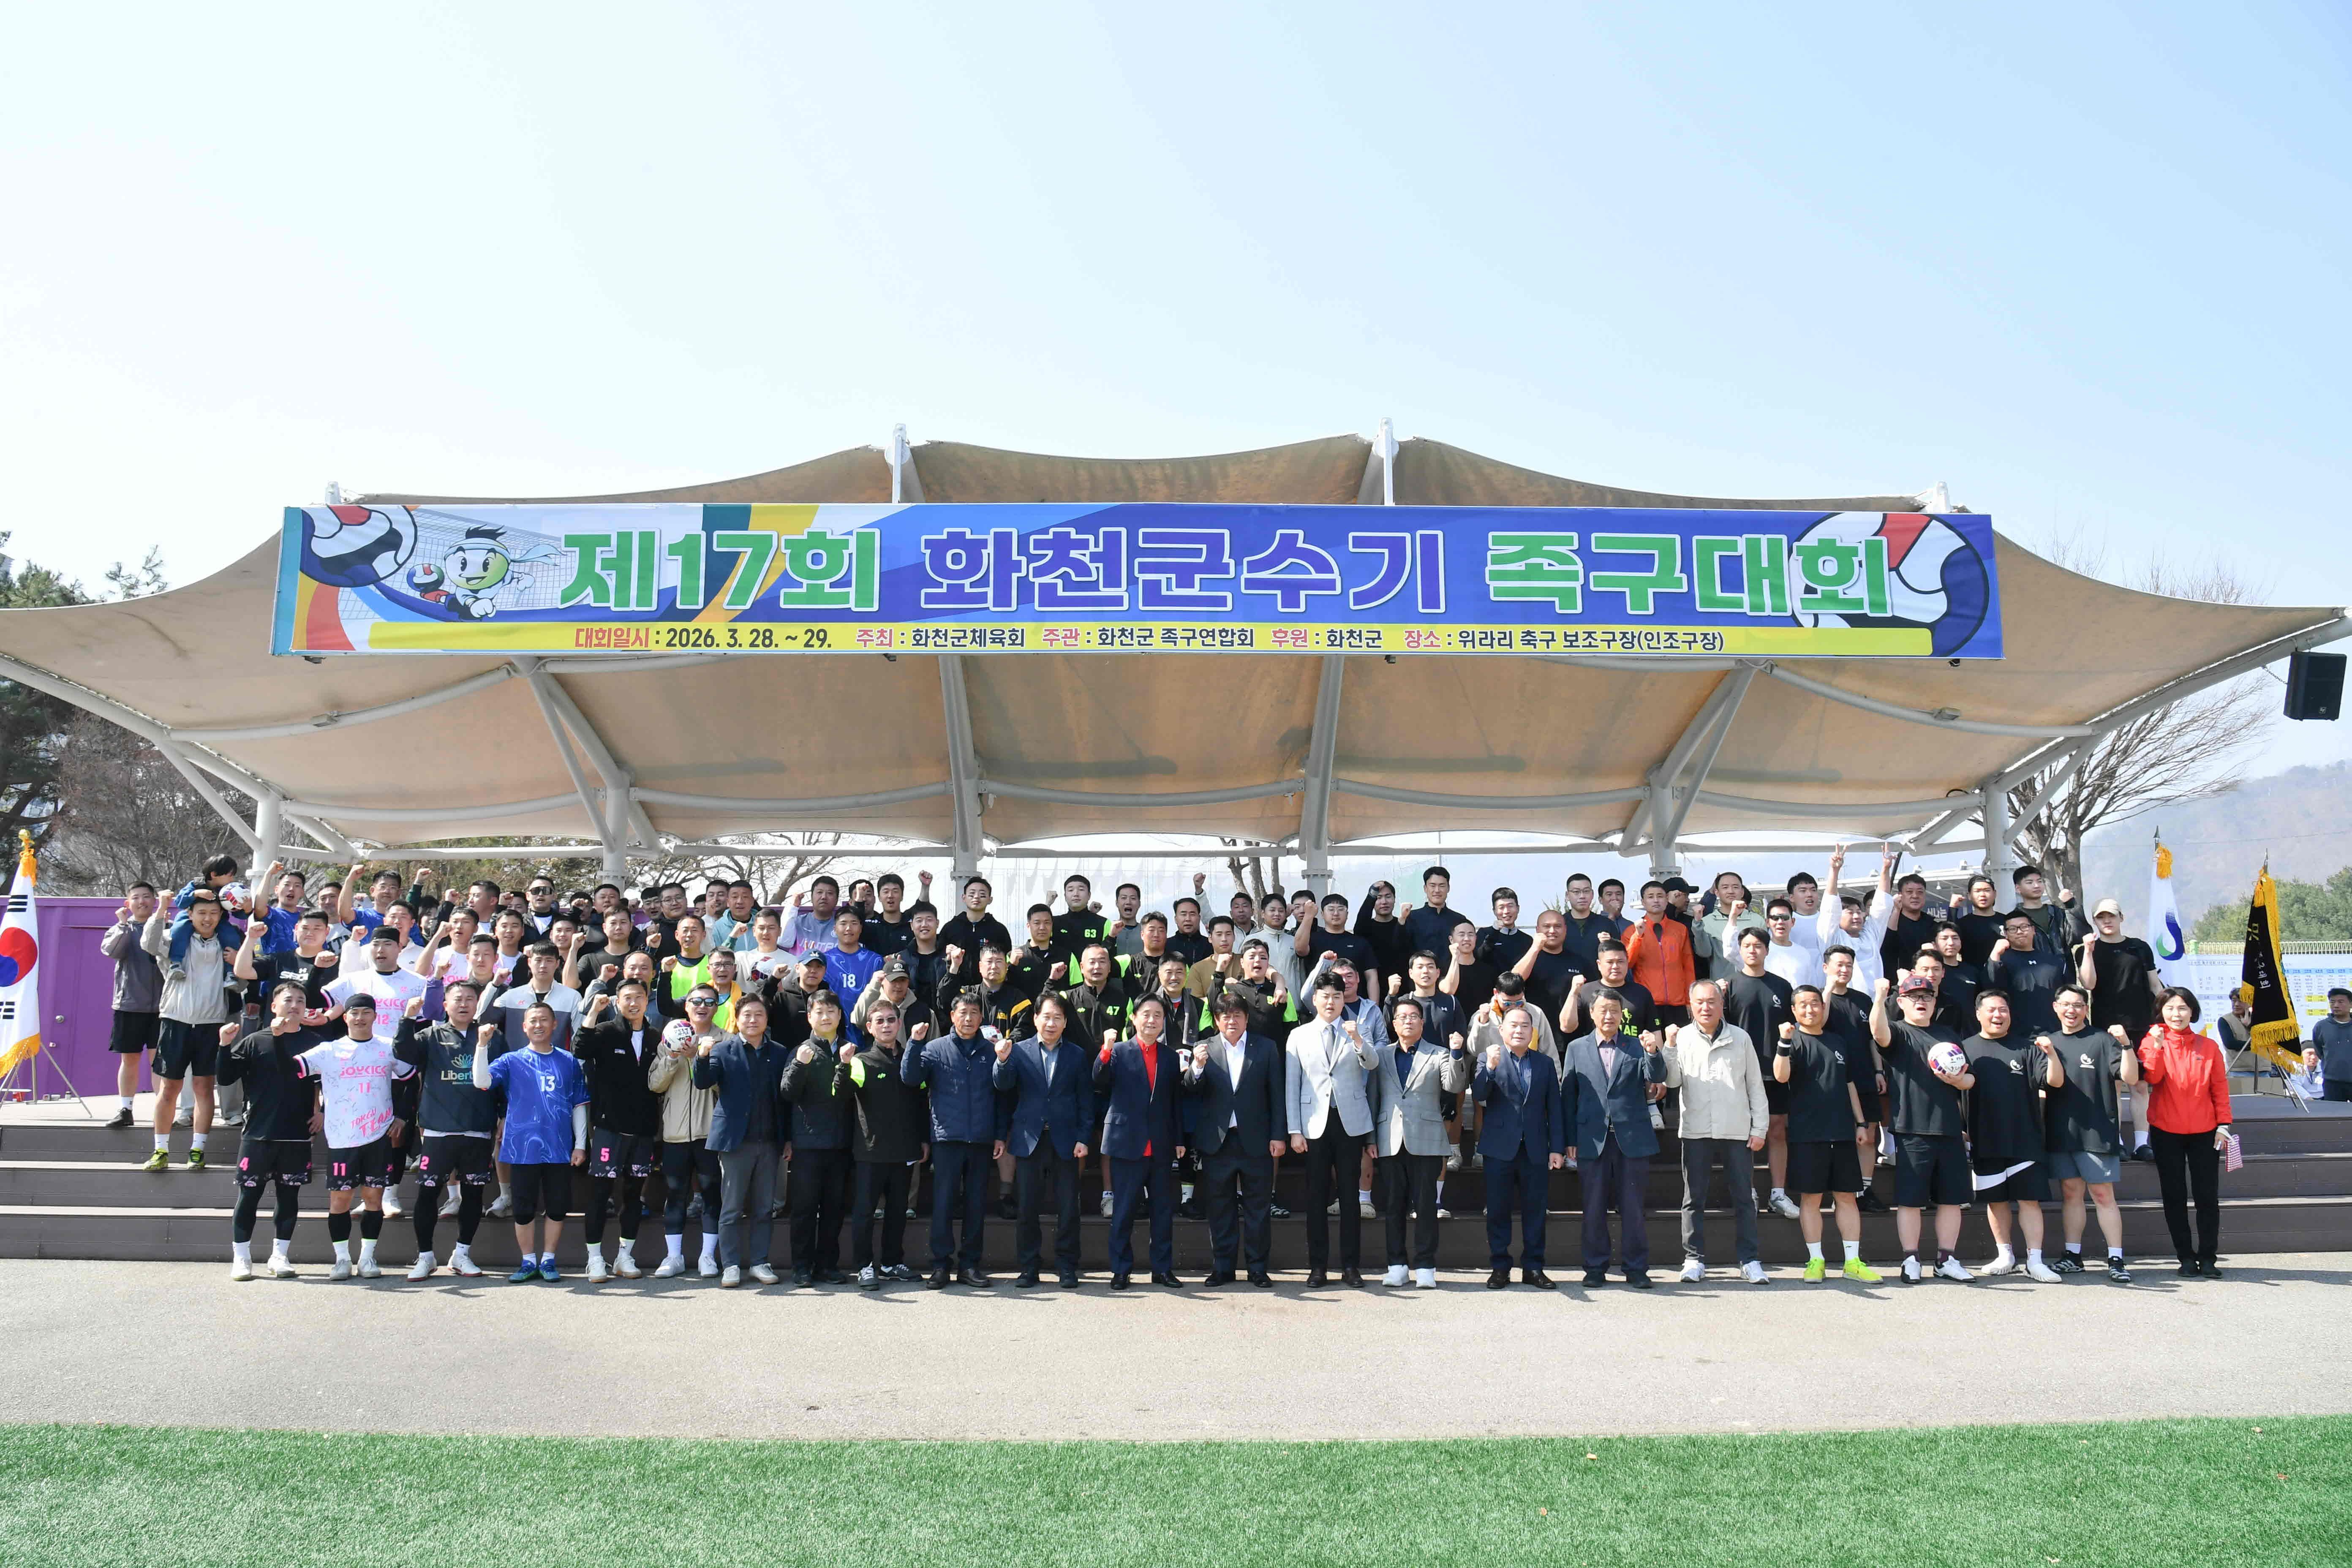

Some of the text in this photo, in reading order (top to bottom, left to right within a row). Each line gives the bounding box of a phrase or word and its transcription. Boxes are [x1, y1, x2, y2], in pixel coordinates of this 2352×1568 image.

[558, 527, 1892, 618] 제17회 화천군수기 족구대회
[574, 628, 650, 648] 대회일시
[666, 628, 720, 648] 2026.
[727, 629, 742, 648] 3.
[749, 629, 779, 648] 28.
[803, 629, 832, 648] 29.
[911, 628, 1025, 648] 화천군체육회
[1097, 627, 1154, 647] 화천군
[1160, 628, 1254, 648] 족구연합회
[1326, 629, 1383, 648] 화천군
[1458, 630, 1513, 649] 위라리
[1520, 630, 1557, 650] 축구
[1563, 630, 1724, 651] 보조구장(인조구장)
[1084, 929, 1096, 938] 63
[842, 973, 856, 988] 18
[1106, 1005, 1120, 1015] 47
[377, 1014, 389, 1024] 12
[1619, 1024, 1638, 1037] AE
[441, 1070, 473, 1080] Libert
[359, 1082, 371, 1093] 11
[540, 1076, 555, 1092] 13
[600, 1148, 610, 1162] 5
[239, 1157, 249, 1171] 4
[333, 1162, 346, 1176] 11
[420, 1156, 430, 1170] 2
